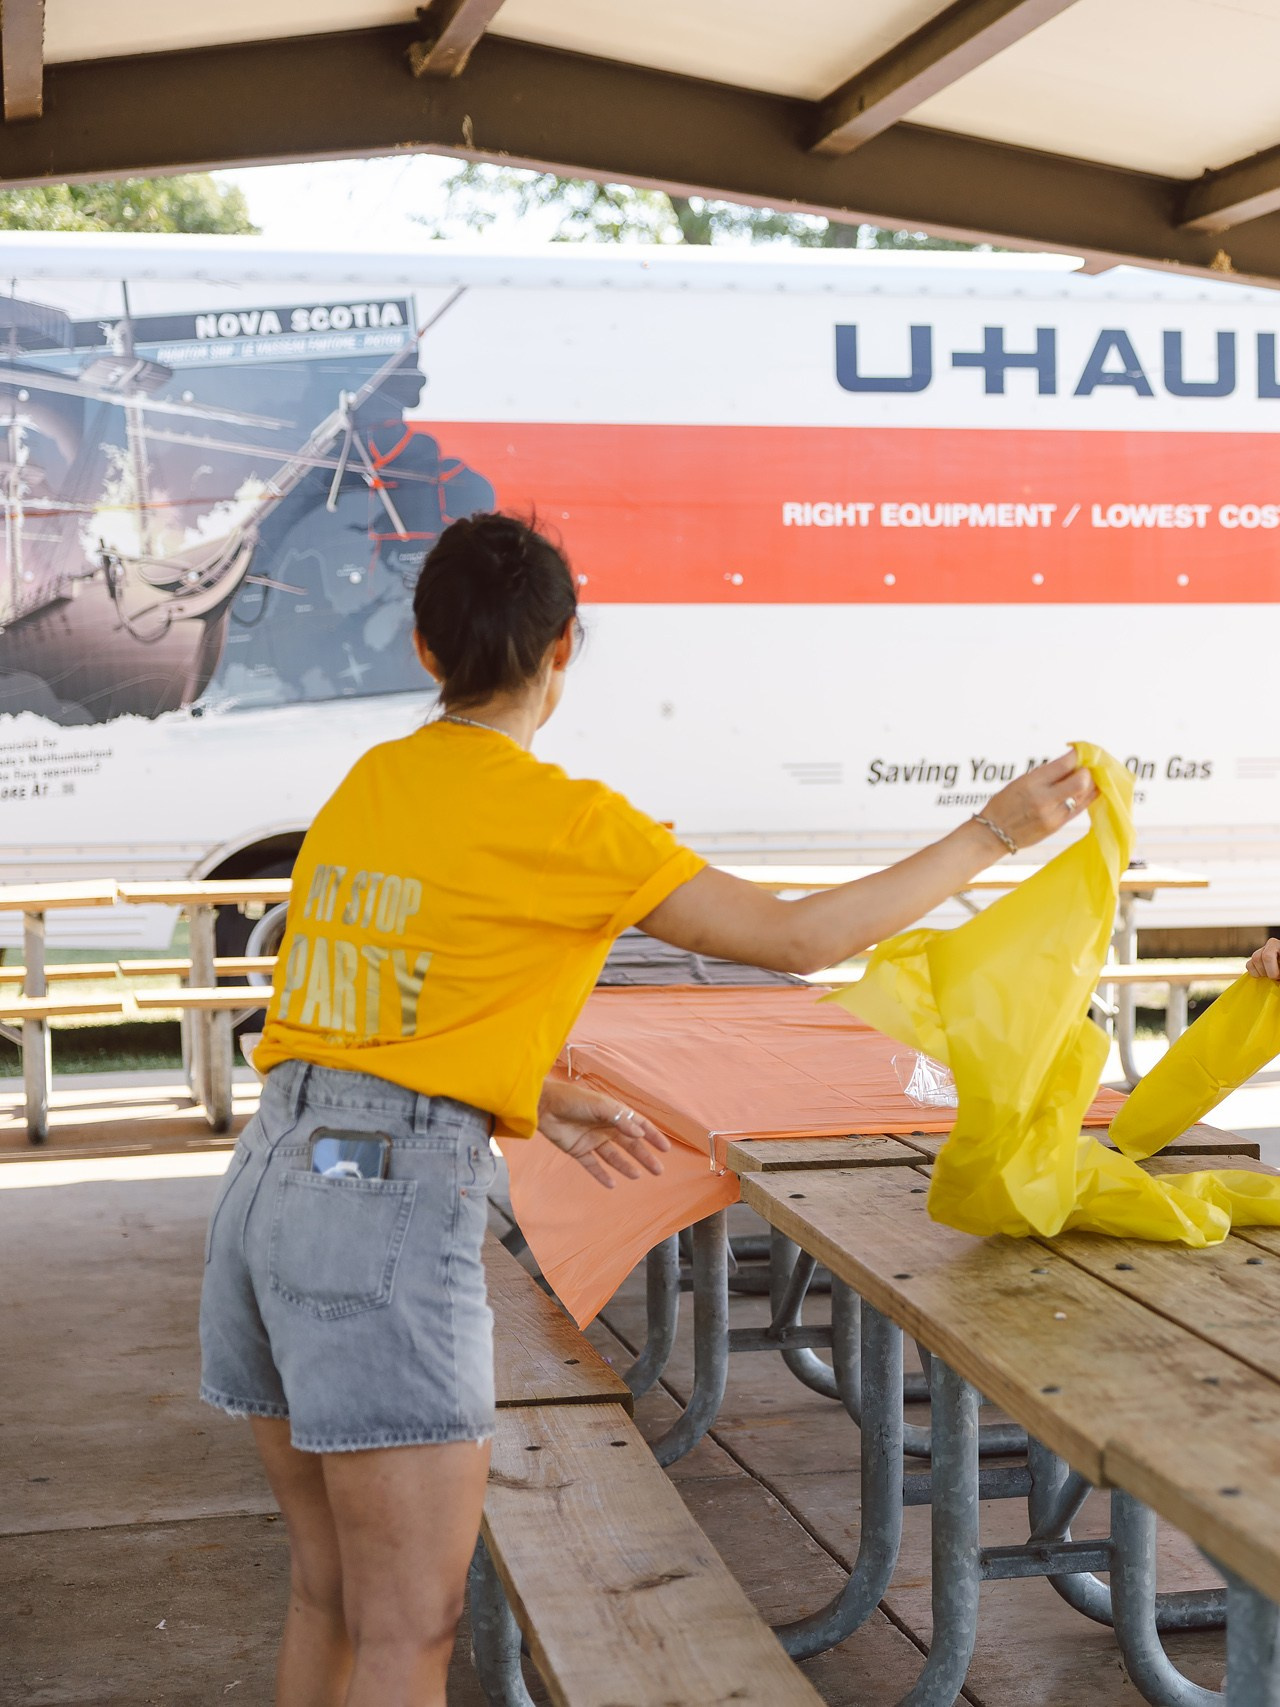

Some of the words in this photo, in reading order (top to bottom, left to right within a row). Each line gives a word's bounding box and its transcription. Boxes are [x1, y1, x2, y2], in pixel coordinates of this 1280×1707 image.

[195, 310, 282, 339] NOVA
[291, 302, 403, 333] SCOTIA
[782, 501, 874, 526] RIGHT
[880, 502, 1057, 528] EQUIPMENT
[1062, 504, 1081, 528] /
[1091, 504, 1211, 528] LOWEST
[971, 757, 1016, 781] You
[1125, 756, 1155, 779] On
[1166, 755, 1212, 780] Gas
[304, 864, 348, 922] PIT
[342, 870, 422, 935] STOP
[278, 934, 434, 1037] PARTY
